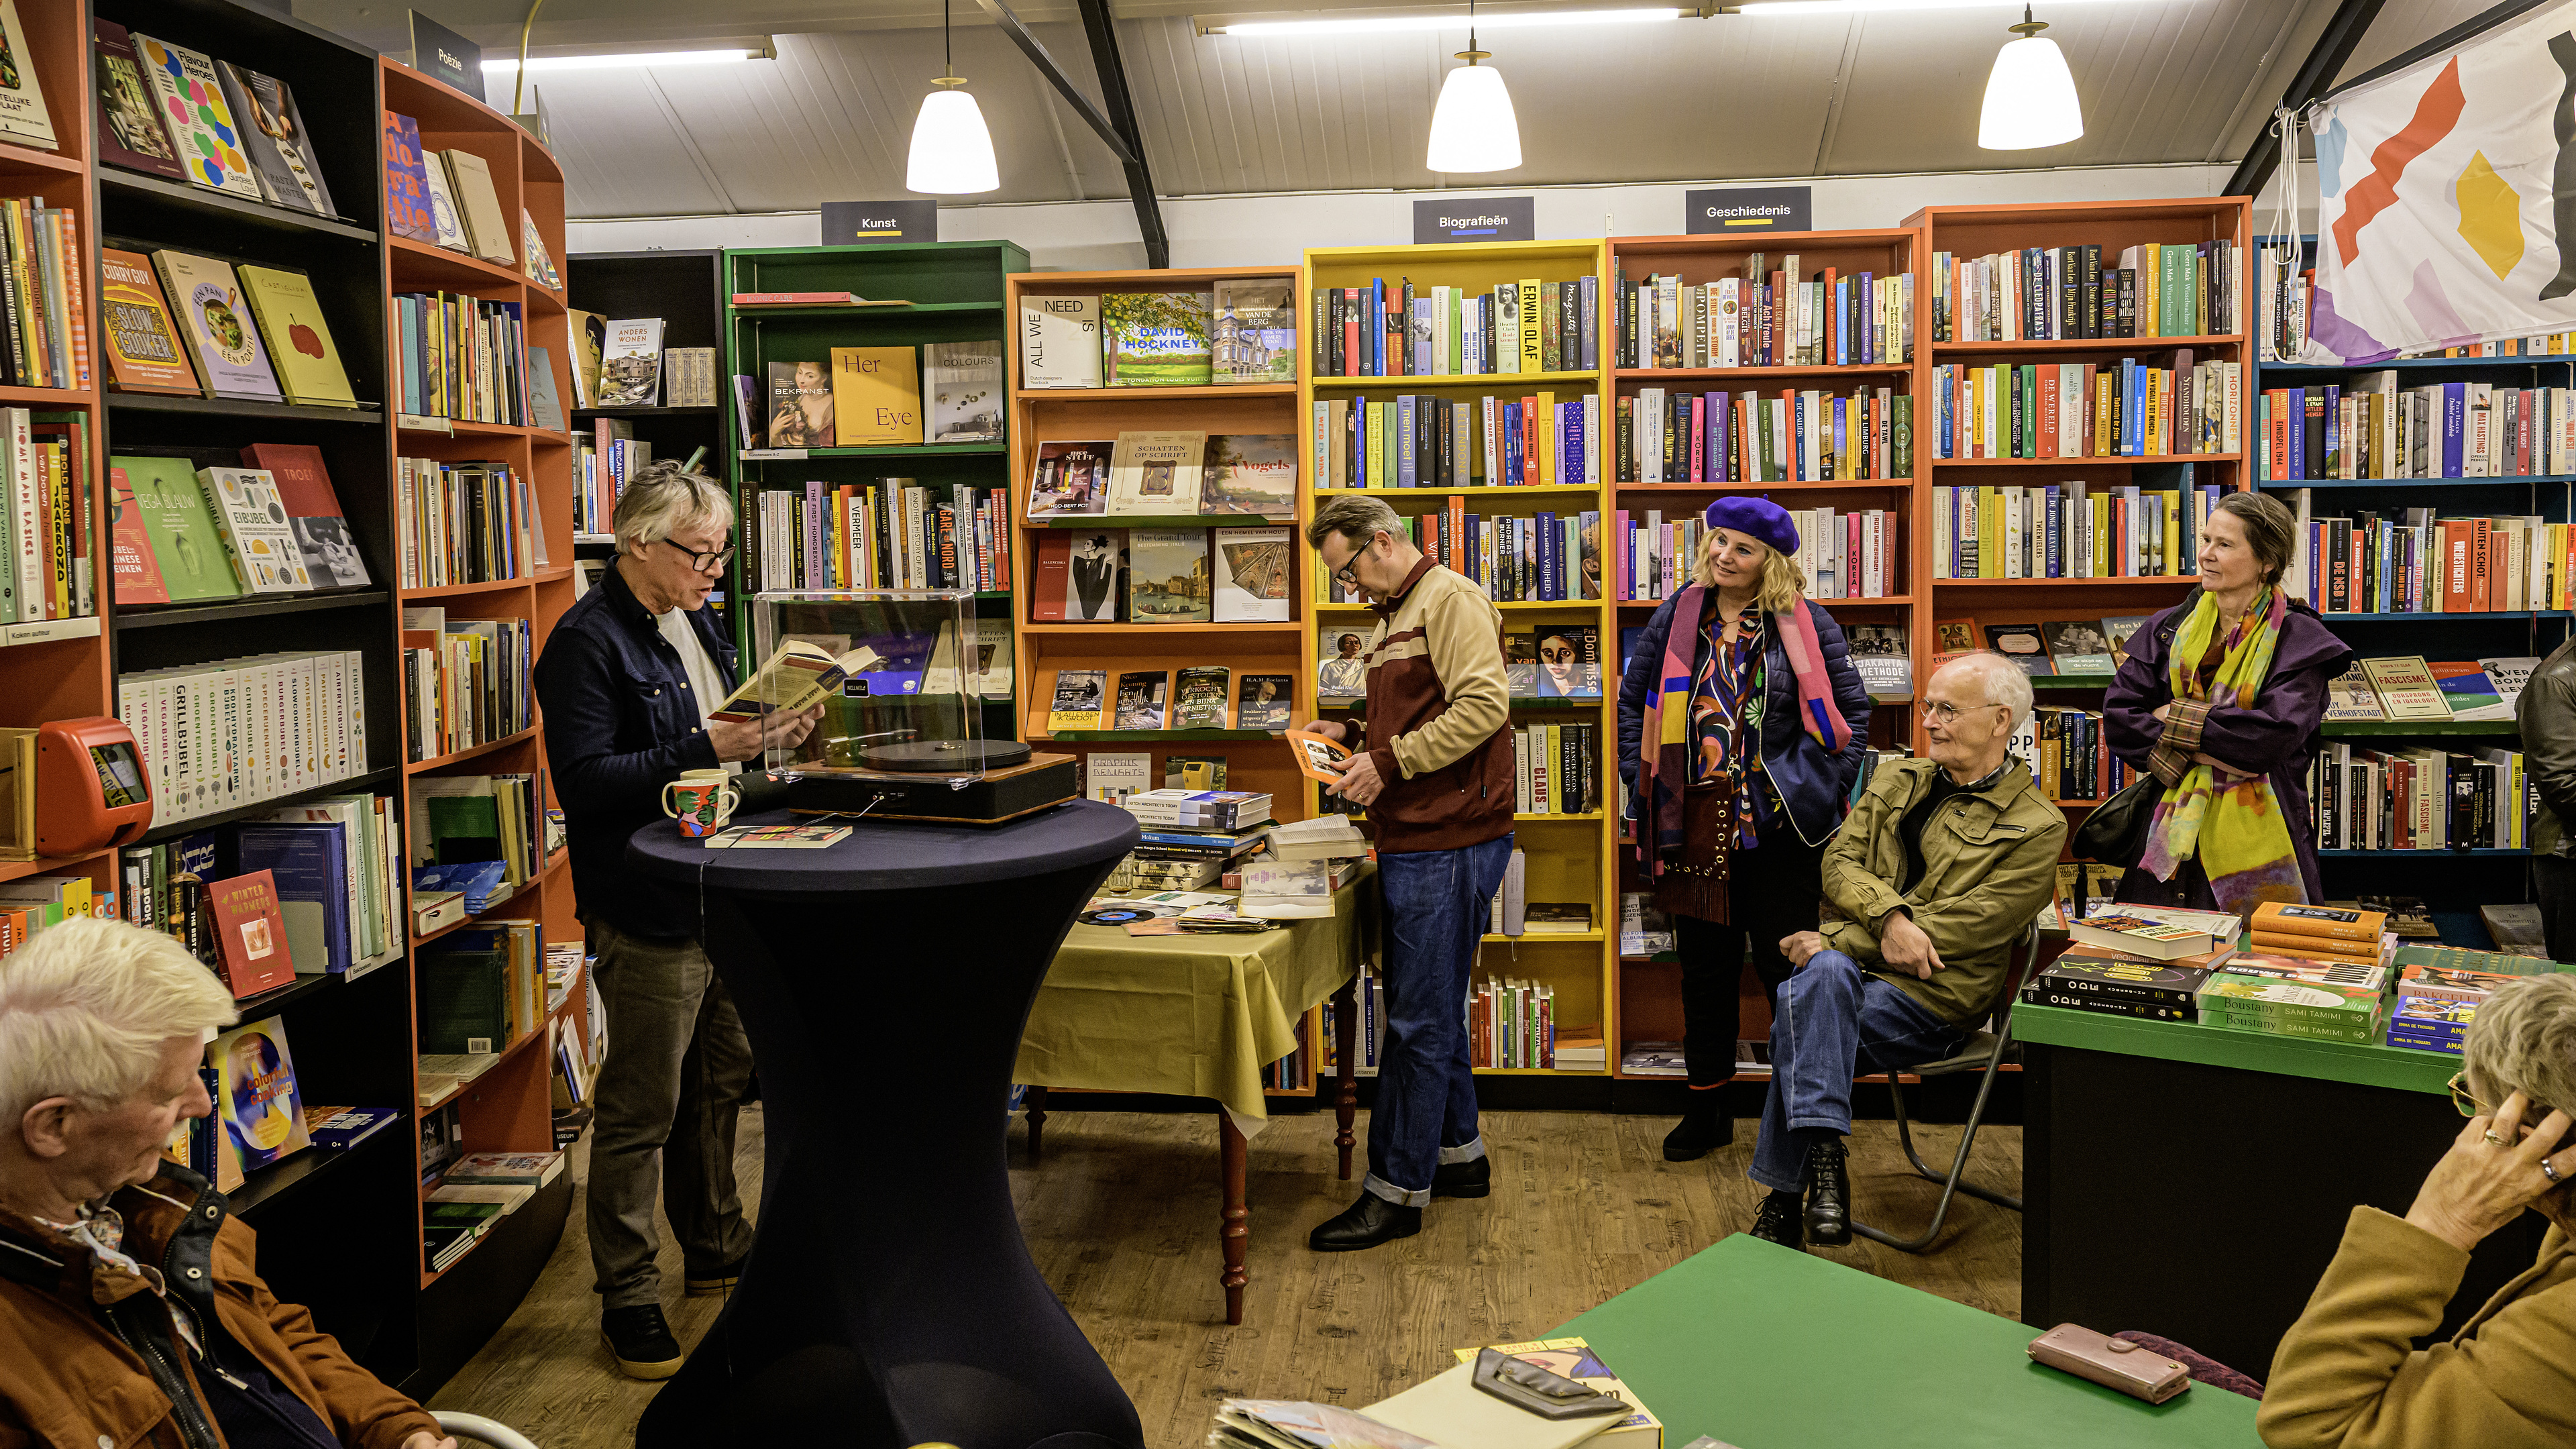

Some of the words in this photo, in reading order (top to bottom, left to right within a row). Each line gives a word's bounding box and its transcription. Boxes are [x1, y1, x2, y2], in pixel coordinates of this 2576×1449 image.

[178, 51, 209, 69] Flavour
[439, 48, 462, 70] Poëzie
[183, 62, 215, 81] Heroes
[227, 172, 253, 185] Gurdeep
[270, 174, 294, 186] PASTA
[1439, 215, 1508, 228] Biografieën
[1707, 205, 1790, 217] Geschiedenis
[862, 219, 896, 228] Kunst
[2166, 250, 2174, 267] Geert
[131, 270, 150, 286] GUY
[1045, 301, 1083, 312] NEED
[1523, 286, 1536, 323] ERWIN
[1763, 305, 1772, 321] Ach
[2165, 284, 2174, 325] Wisselwachter
[115, 306, 153, 332] SLOW
[1029, 314, 1041, 338] WE
[1697, 296, 1705, 354] POMPEII
[1140, 328, 1185, 336] DAVID
[1763, 323, 1772, 348] freule
[120, 331, 172, 358] COOKER
[1031, 341, 1043, 368] ALL
[1126, 340, 1200, 349] HOCKNEY
[1524, 329, 1537, 360] OLAF
[844, 356, 880, 373] Her
[943, 358, 994, 367] COLOURS
[2048, 379, 2055, 392] DE
[2184, 376, 2192, 433] STANDHOUDEN
[2229, 376, 2237, 441] HORIZONNEN
[875, 408, 912, 430] Eye
[1403, 410, 1411, 431] men
[2477, 413, 2486, 425] MAX
[1403, 434, 1411, 460] moet
[1458, 408, 1466, 475] KELLENDONK
[2477, 427, 2485, 453] HASTINGS
[60, 454, 68, 484] BOLD
[1242, 460, 1290, 472] Vogels
[165, 494, 195, 508] BLAUW
[852, 506, 861, 549] VERMEER
[940, 510, 953, 533] GARE
[54, 486, 64, 582] JAARROND
[1136, 534, 1151, 542] The
[1154, 534, 1179, 542] Grand
[1180, 533, 1201, 541] Tour
[2478, 521, 2486, 549] BUITEN
[942, 543, 954, 569] NORD
[2477, 551, 2485, 578] SCHOT.
[2453, 541, 2465, 594] VREDESTICHTERS
[1326, 629, 1338, 655] Charley
[1584, 635, 1597, 693] Dommisse
[1859, 659, 1902, 667] JAKARTA
[1860, 667, 1904, 676] METHODE
[2378, 674, 2429, 685] FASCISME
[2447, 696, 2470, 704] polder
[2327, 709, 2382, 718] VERHOFSTADT
[229, 689, 239, 790] KOOLHYDRAATARME
[1534, 767, 1547, 803] CLAUS
[2421, 800, 2429, 834] FASCISME
[231, 885, 264, 901] WINTER
[230, 897, 270, 916] WARMERS
[2257, 920, 2294, 931] STANLEY
[2297, 925, 2327, 933] TUCCI
[2224, 998, 2275, 1014] Boustany
[2285, 1009, 2308, 1018] SAMI
[2310, 1010, 2341, 1020] TAMIMI
[2226, 1014, 2276, 1030] Boustany
[2287, 1024, 2308, 1033] SAMI
[2312, 1027, 2343, 1037] TAMIMI
[248, 1064, 290, 1091] colorful
[250, 1081, 294, 1106] cooking
